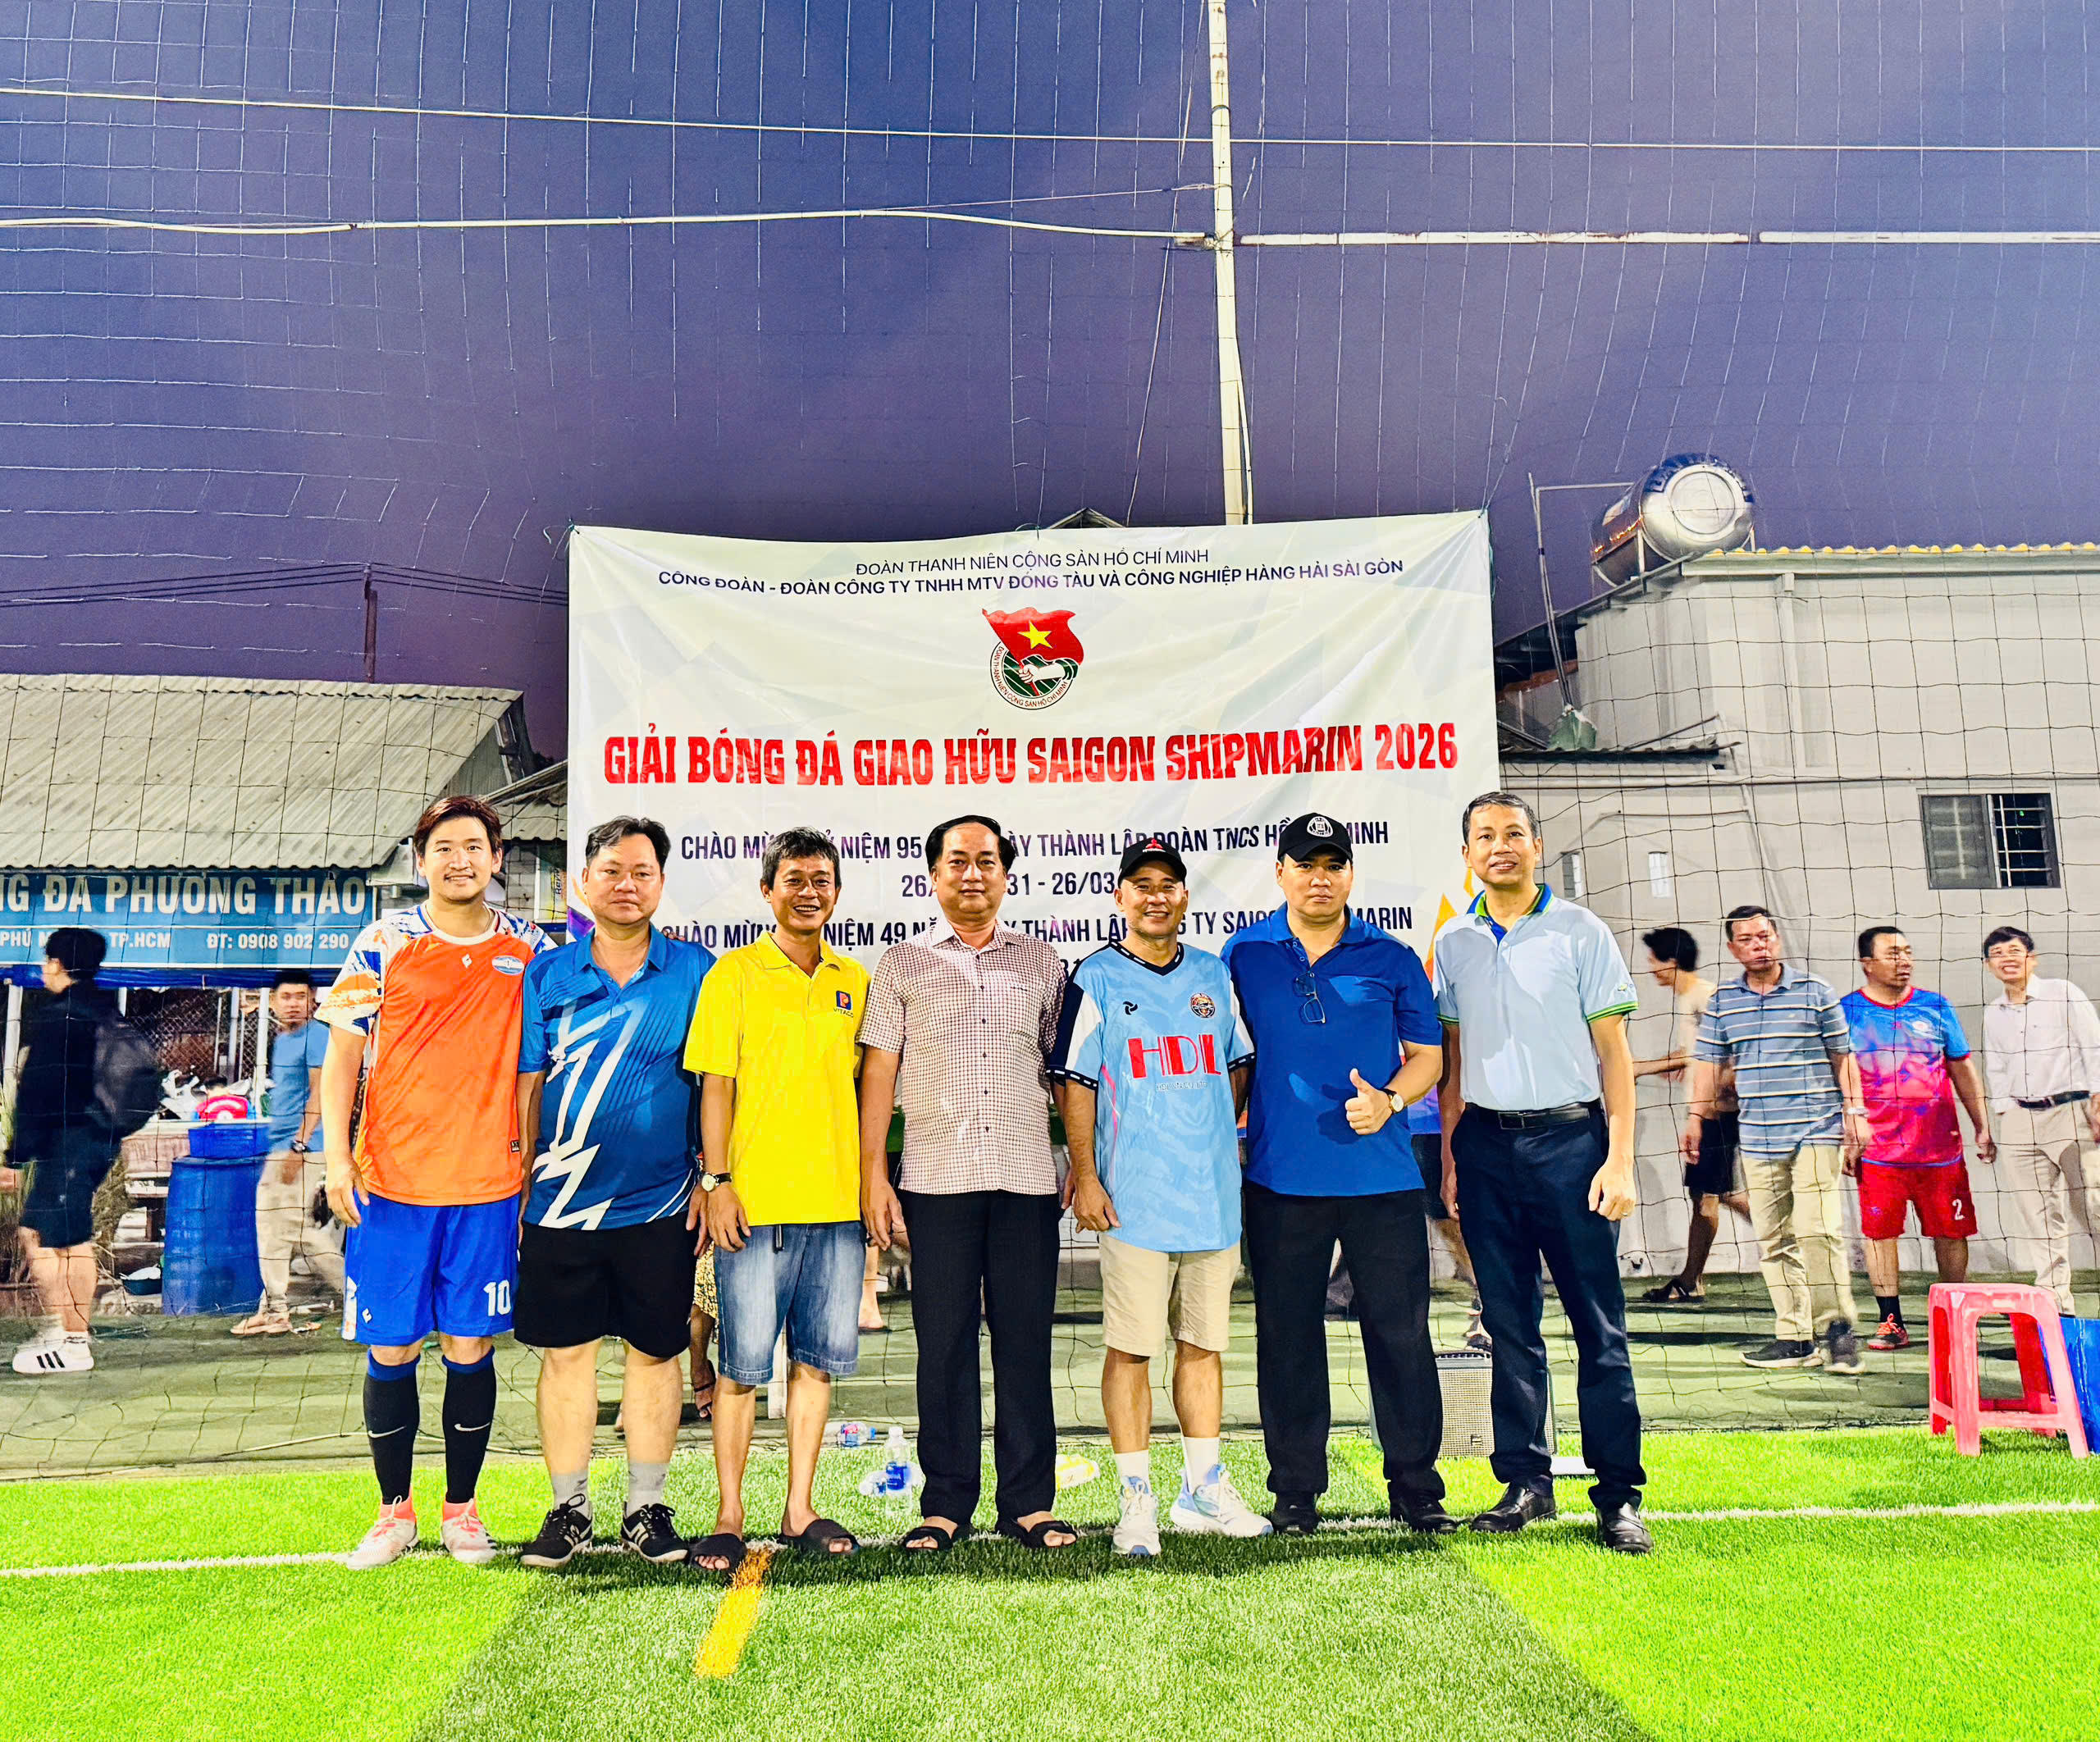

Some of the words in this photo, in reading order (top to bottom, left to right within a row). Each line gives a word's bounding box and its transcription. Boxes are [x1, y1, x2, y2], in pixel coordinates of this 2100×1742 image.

[659, 571, 710, 586] CÔNG
[714, 577, 765, 593] ĐOÀN
[780, 579, 830, 595] ĐOÀN
[834, 579, 885, 595] CÔNG
[889, 581, 910, 594] TY
[915, 578, 963, 592] TNHH
[967, 577, 1004, 591] MTV
[1009, 571, 1058, 589] ĐÓNG
[1063, 570, 1094, 588] TÀU
[1099, 570, 1121, 586] VÀ
[1125, 569, 1175, 586] CÔNG
[1179, 566, 1241, 586] NGHIỆP
[1246, 564, 1295, 581] HÀNG
[1332, 559, 1360, 577] SÀI
[1364, 558, 1403, 575] GÒN
[856, 560, 903, 575] ĐOÀN
[908, 557, 966, 572] THANH
[970, 553, 1008, 570] NIÊN
[1012, 551, 1061, 570] CỘNG
[1104, 548, 1129, 566] HỒ
[1133, 547, 1162, 564] CHÍ
[1166, 549, 1208, 563] MINH
[605, 723, 677, 784] GIẢI
[687, 727, 784, 785] BÓNG
[796, 730, 843, 786] ĐÁ
[853, 739, 934, 786] GIAO
[944, 727, 1017, 785] HỮU
[1027, 736, 1155, 783] SAIGON
[1166, 725, 1363, 782] SHIPMARIN
[1375, 723, 1458, 770] 2026
[682, 832, 736, 859] CHÀO
[841, 832, 891, 863] NIỆM
[897, 837, 921, 859] 95
[1037, 829, 1105, 856] THÀNH
[1213, 825, 1259, 850] TNCS
[109, 932, 171, 949] TP.HCM
[207, 933, 233, 949] ĐT:
[238, 933, 278, 949] 0908
[284, 933, 313, 949] 902
[318, 933, 349, 950] 290
[824, 918, 874, 951] NIỆM
[880, 922, 906, 945] 49
[1022, 914, 1090, 942] THÀNH
[1192, 911, 1217, 935] TY
[1952, 1199, 1965, 1220] 2
[483, 1279, 512, 1316] 10
